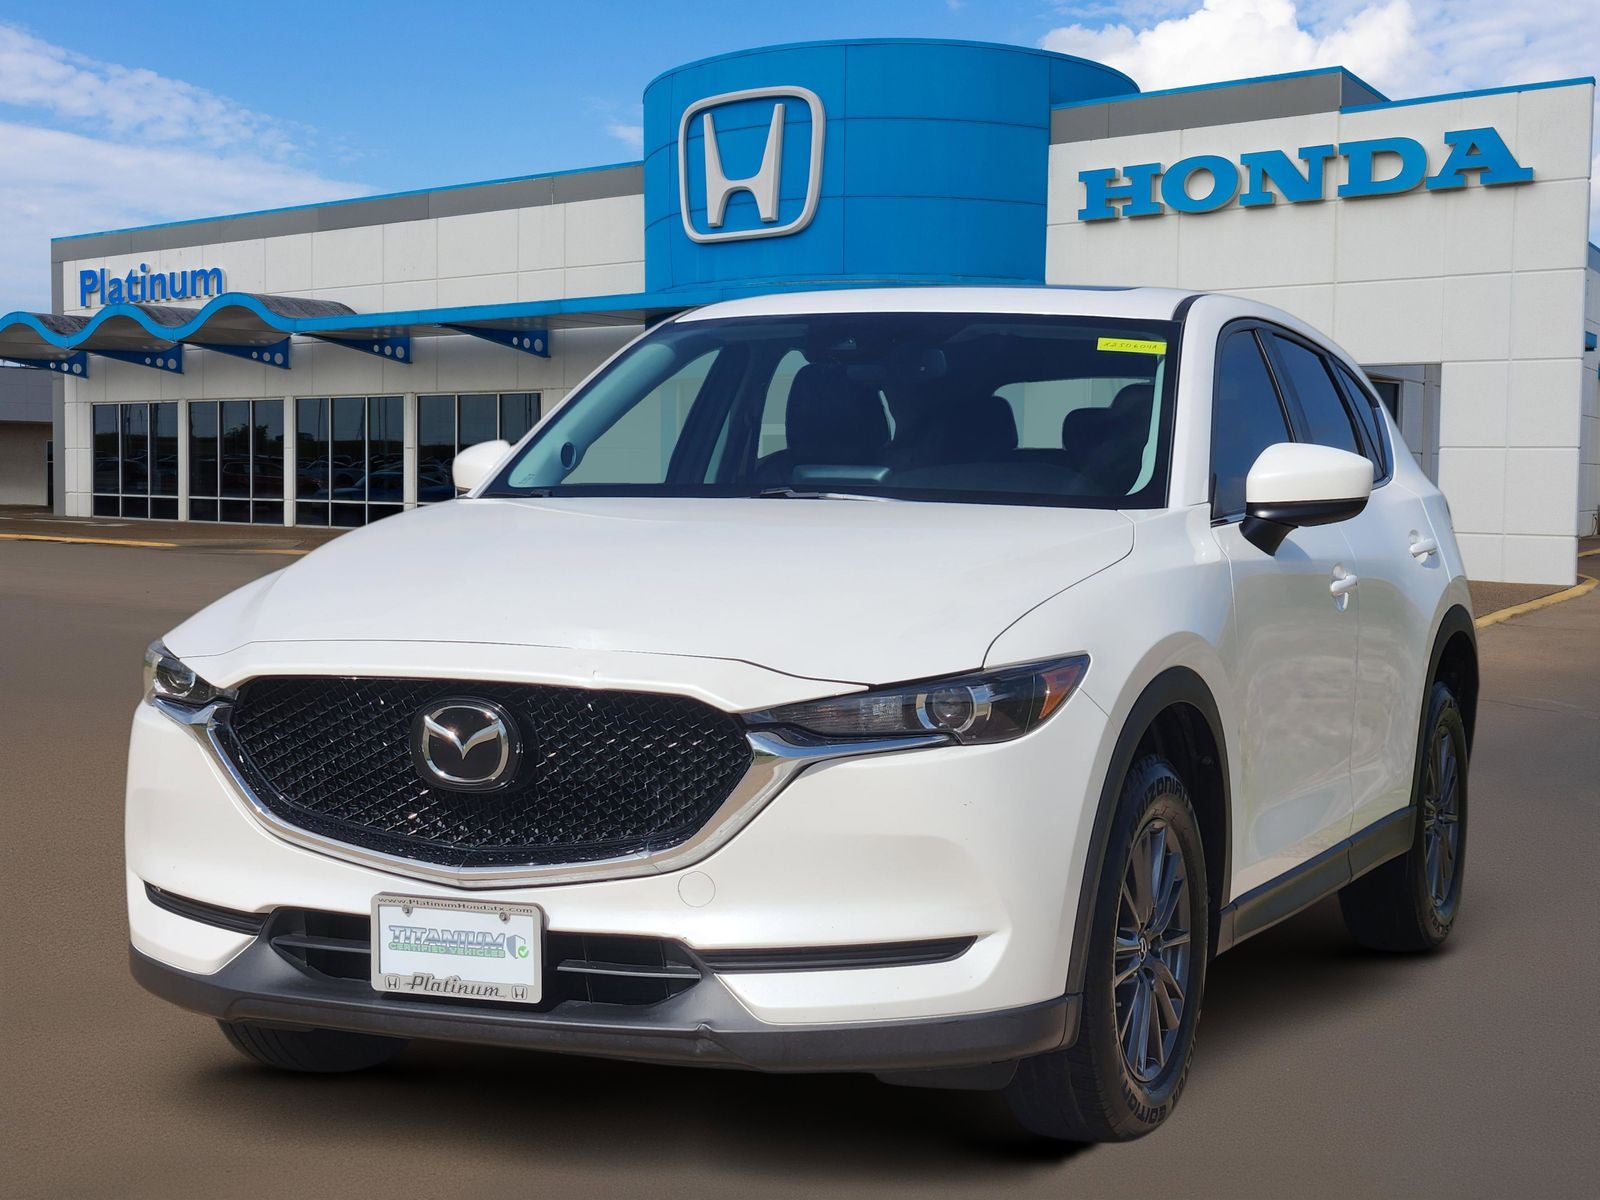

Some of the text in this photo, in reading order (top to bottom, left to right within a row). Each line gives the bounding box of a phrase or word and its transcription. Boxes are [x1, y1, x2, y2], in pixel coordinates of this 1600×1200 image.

[1078, 127, 1534, 222] HONDA
[79, 263, 224, 307] Platinum
[389, 925, 506, 949] TITANIUM
[389, 943, 506, 958] CERTIFIED VEHICLES
[404, 974, 505, 998] Platinum
